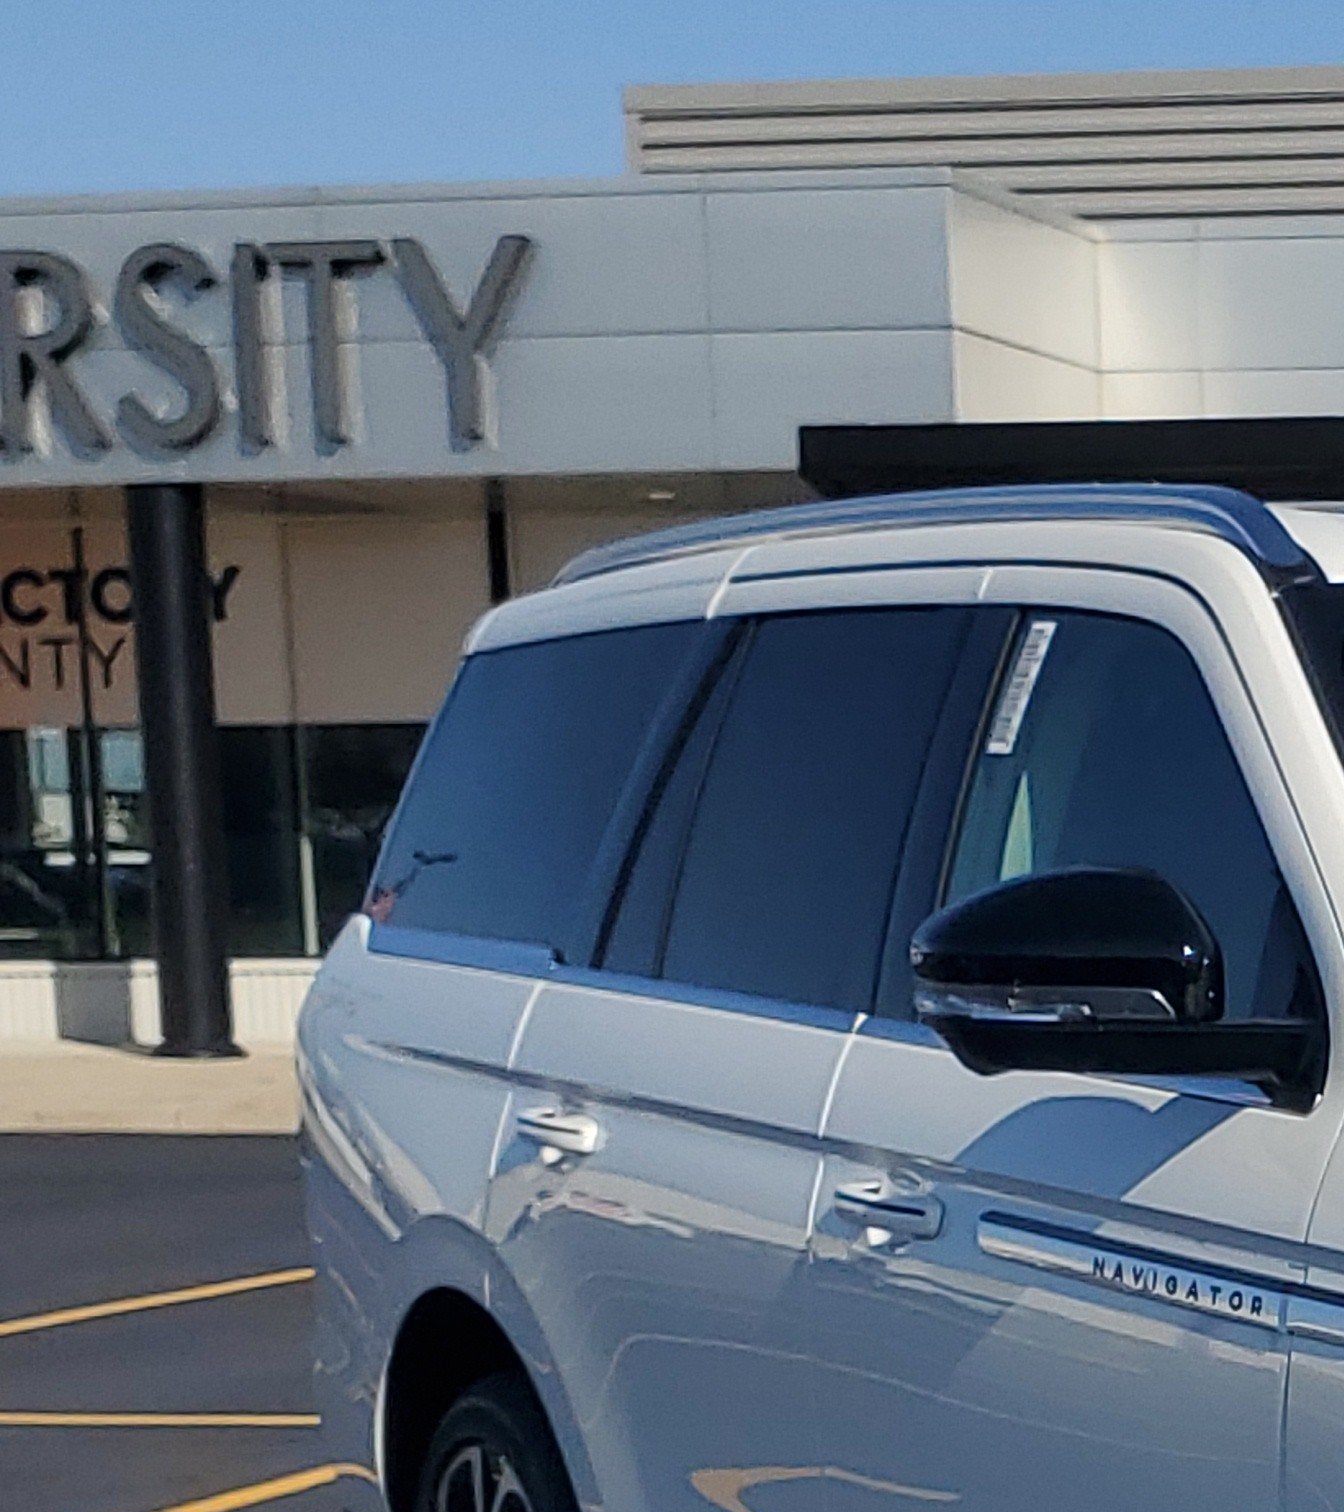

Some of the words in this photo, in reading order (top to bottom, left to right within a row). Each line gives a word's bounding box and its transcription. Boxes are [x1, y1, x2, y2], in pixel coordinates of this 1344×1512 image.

[0, 235, 534, 460] RSITY
[1, 565, 240, 625] CTOY
[1092, 1256, 1263, 1317] NAVIGATOR
